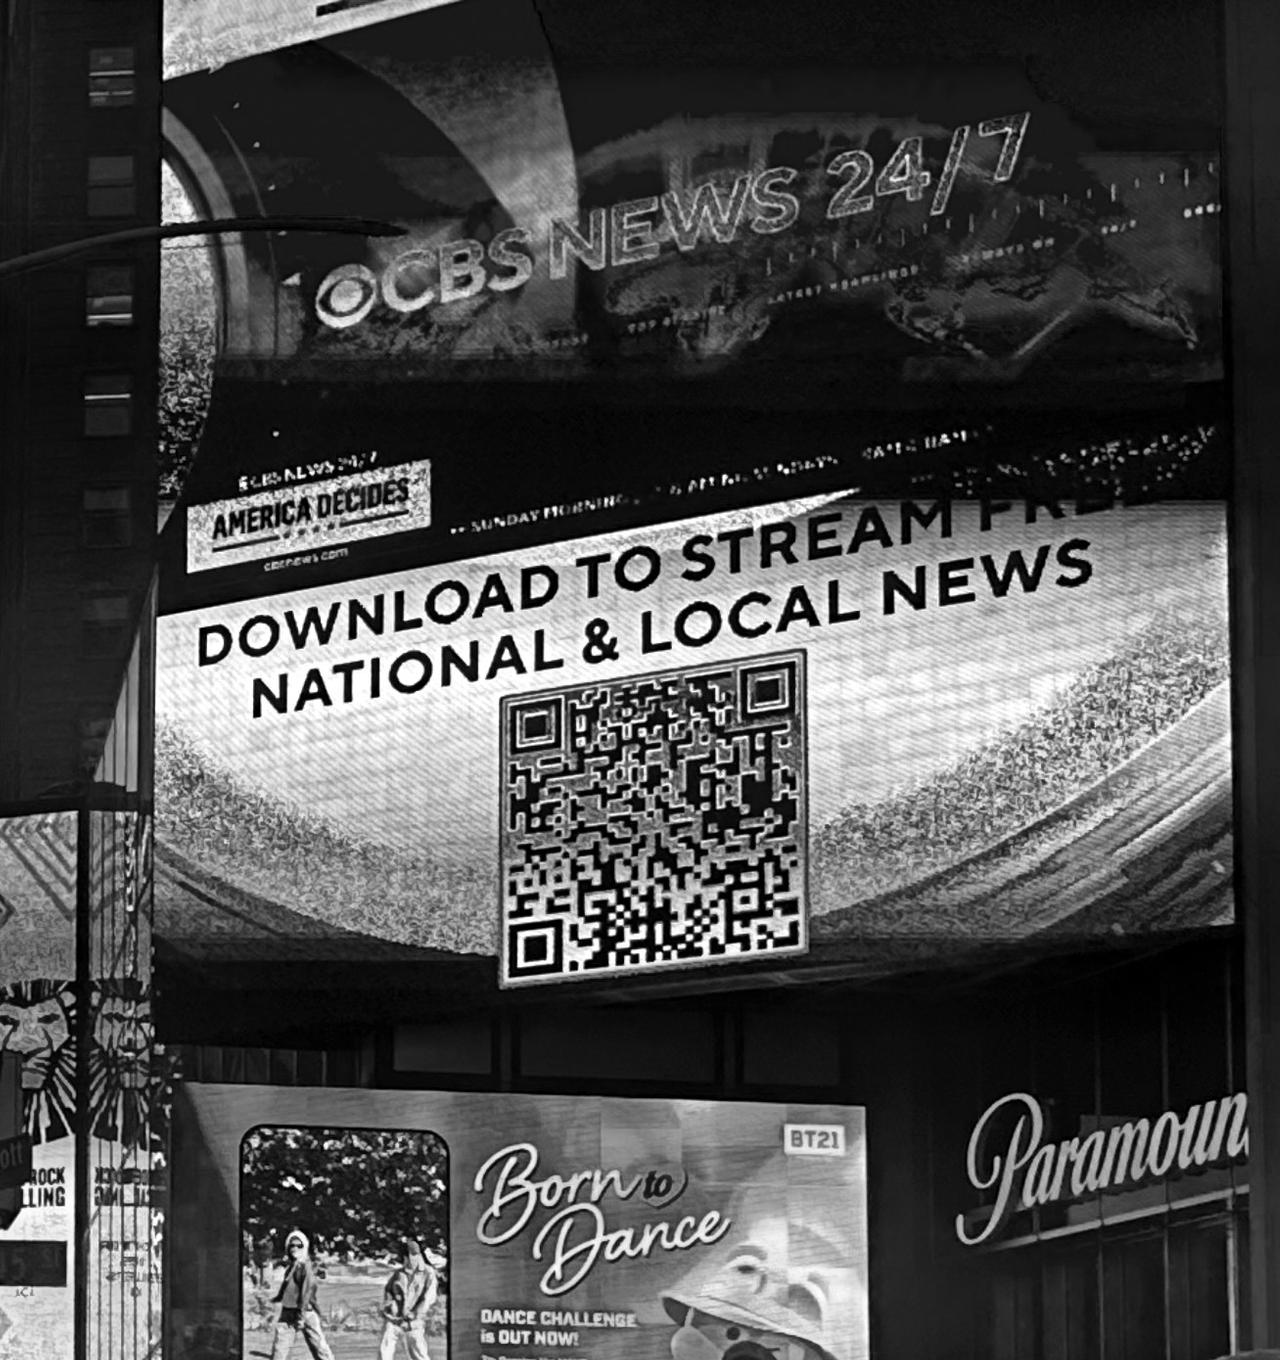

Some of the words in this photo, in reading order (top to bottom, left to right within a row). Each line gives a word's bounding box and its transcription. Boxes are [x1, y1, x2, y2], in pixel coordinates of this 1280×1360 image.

[381, 227, 534, 312] CBS
[548, 166, 800, 281] NEWS
[826, 111, 1032, 219] 24/7
[212, 497, 312, 540] AMERICA
[317, 477, 410, 518] DECIDES
[199, 566, 558, 666] DOWNLOAD
[576, 546, 661, 599] TO
[681, 500, 953, 582] STREAM
[252, 628, 564, 718] NATIONAL
[582, 617, 619, 664] &
[642, 579, 861, 654] LOCAL
[882, 538, 1094, 615] NEWS
[789, 1129, 840, 1150] BT21
[955, 1091, 1250, 1246] Paramoun
[473, 1143, 644, 1246] Born
[644, 1170, 673, 1199] to
[533, 1202, 732, 1297] Dance
[480, 1309, 538, 1326] DANCE
[539, 1309, 637, 1328] CHALLENGE
[480, 1329, 496, 1344] is
[498, 1329, 531, 1345] OUT
[533, 1329, 580, 1347] NOW!
